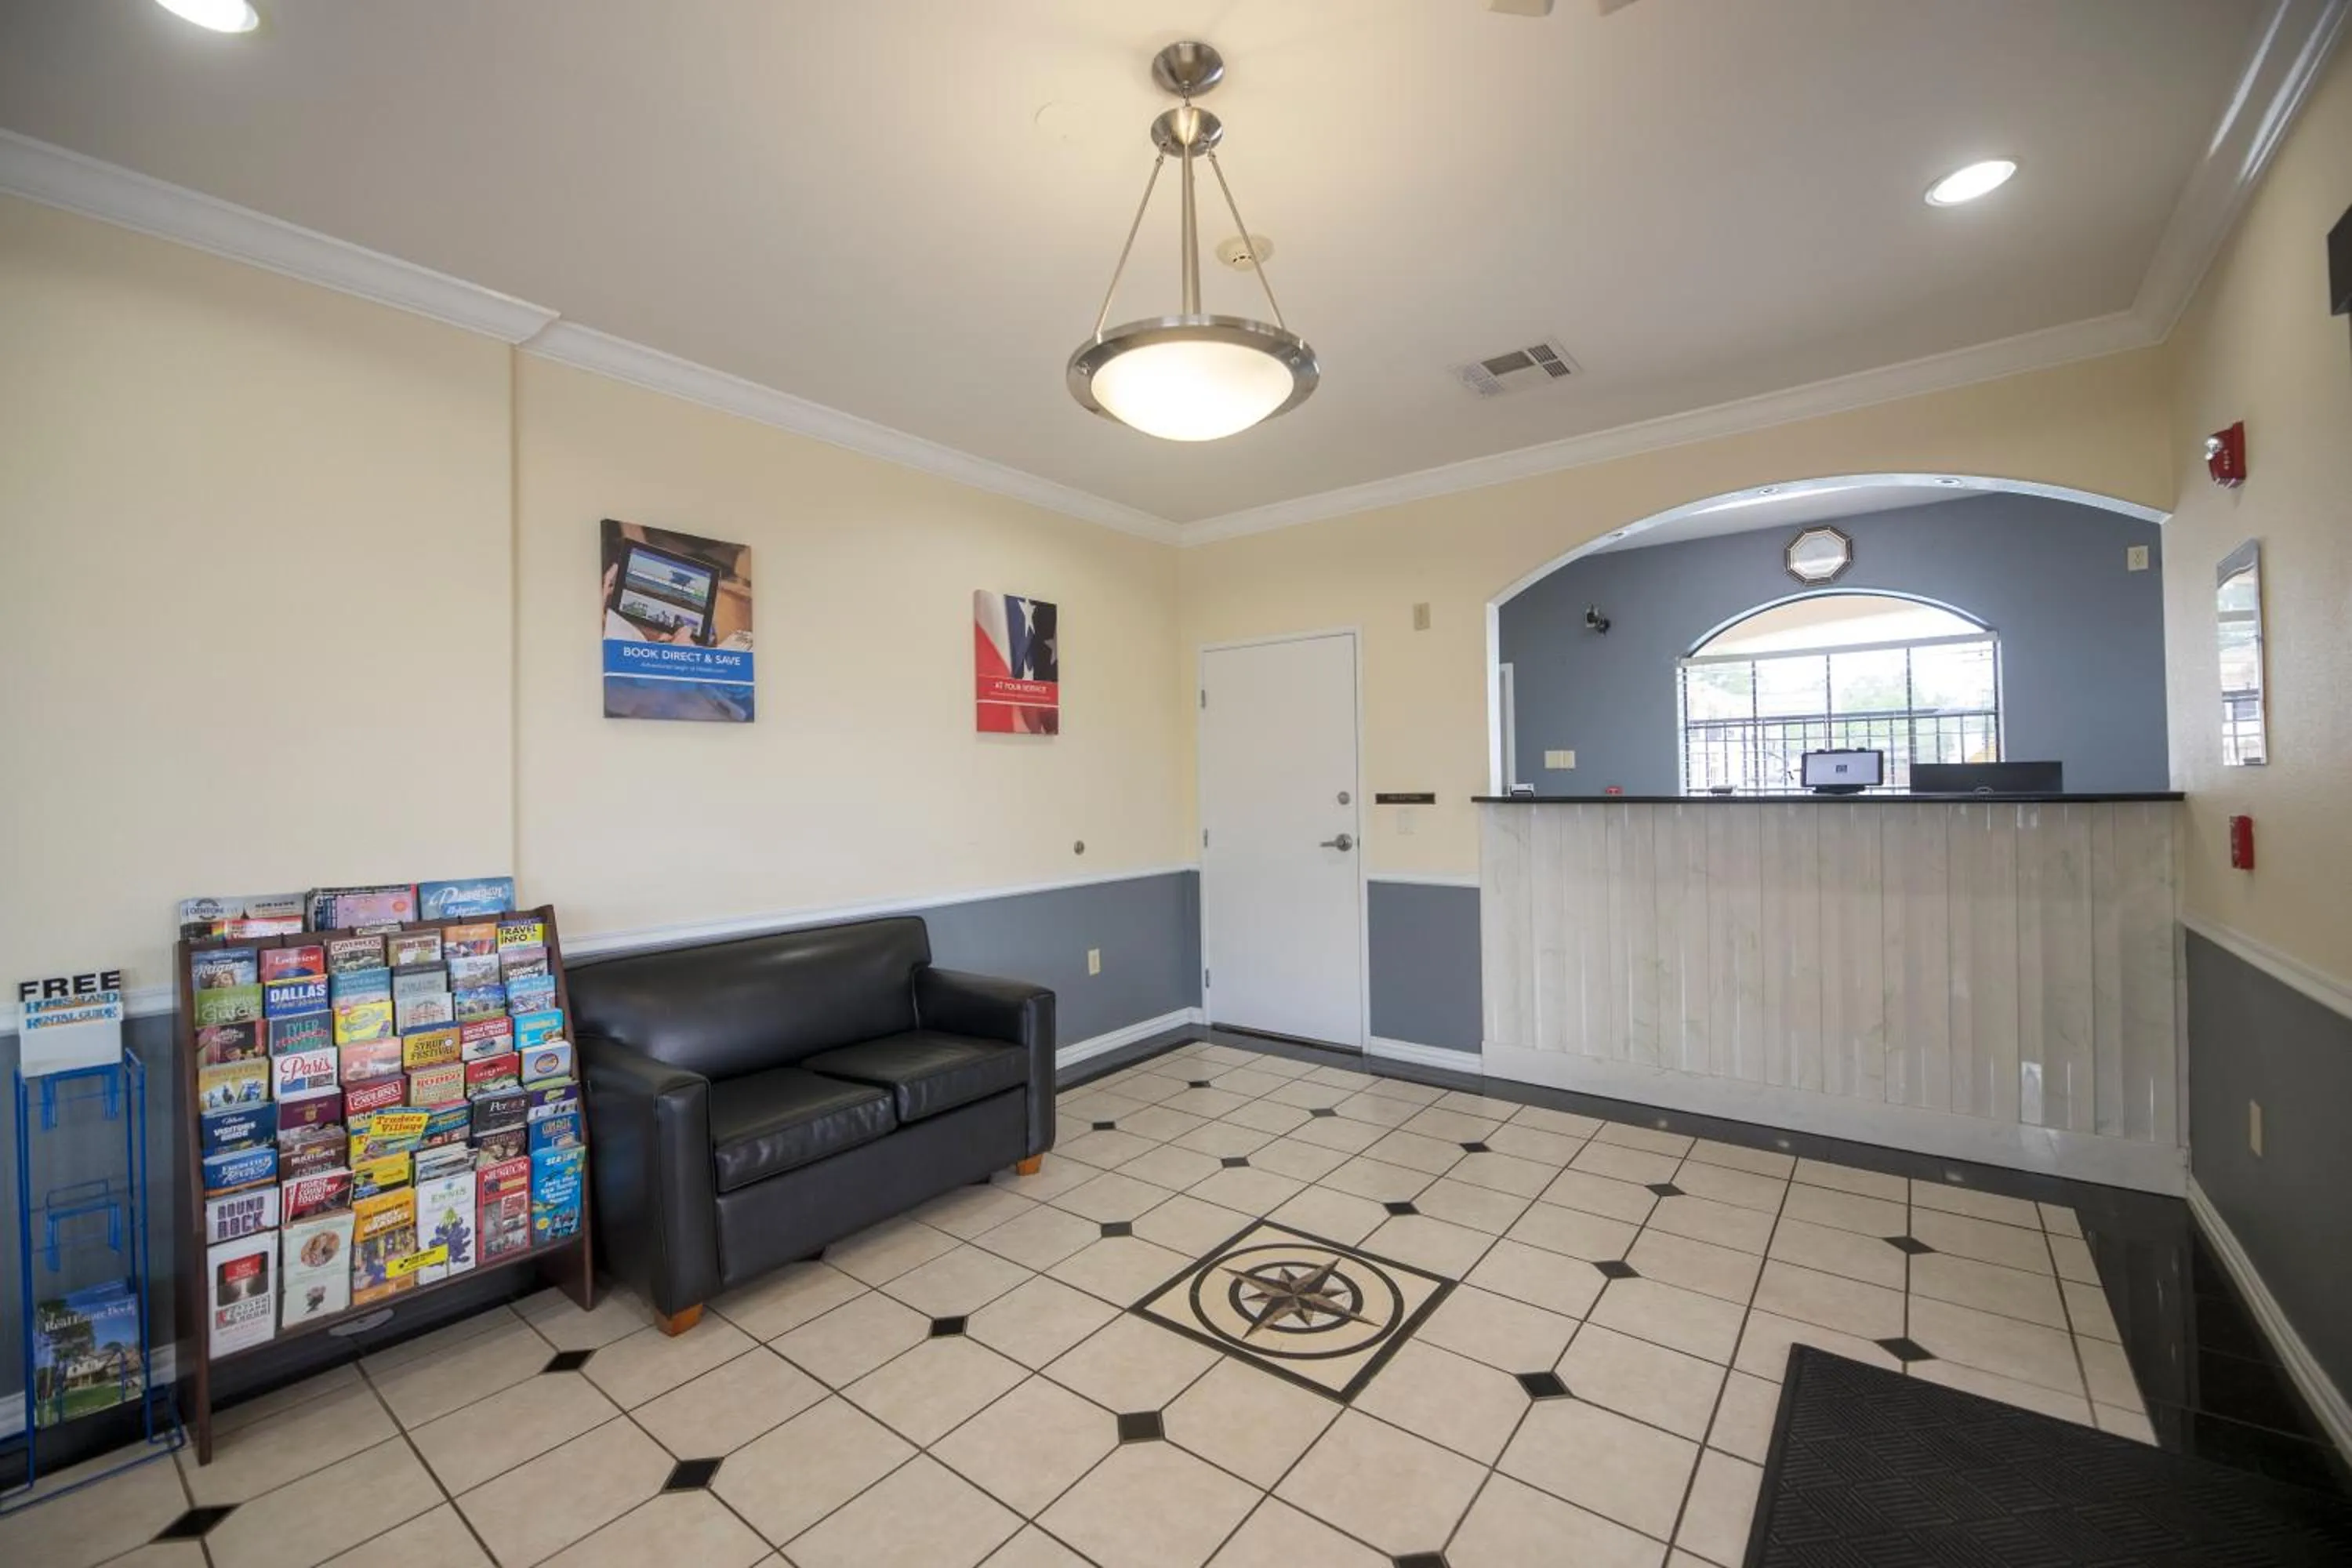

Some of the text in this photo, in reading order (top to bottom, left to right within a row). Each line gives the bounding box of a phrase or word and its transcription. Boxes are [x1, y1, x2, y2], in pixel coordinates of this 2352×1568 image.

[623, 646, 741, 666] BOOK DIRECT & SAVE
[499, 924, 538, 936] TRAVEL
[500, 933, 528, 945] INFO
[19, 971, 121, 1002] FREE
[270, 984, 327, 1004] DALLAS
[280, 1053, 332, 1083] Paris
[213, 1121, 256, 1137] VISITORS
[376, 1115, 423, 1126] Traders
[382, 1122, 422, 1133] Village
[217, 1196, 264, 1220] ROUND
[217, 1211, 265, 1240] ROCK
